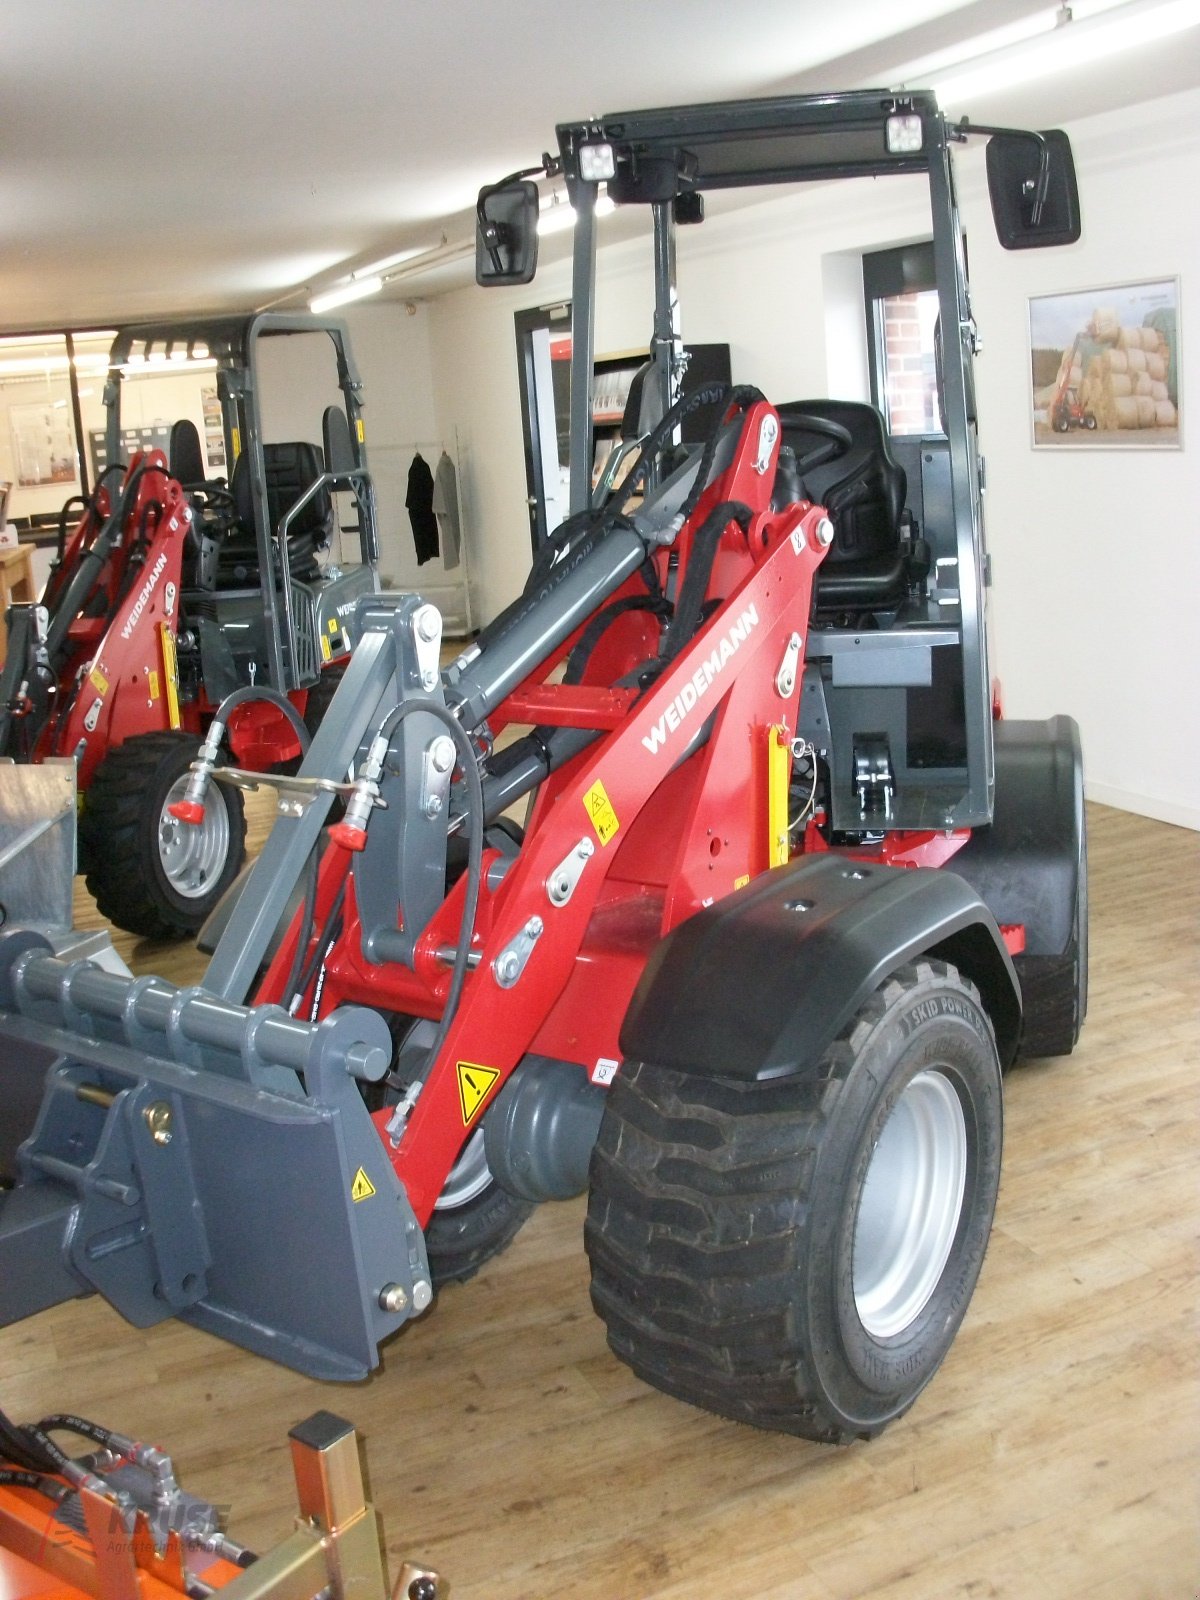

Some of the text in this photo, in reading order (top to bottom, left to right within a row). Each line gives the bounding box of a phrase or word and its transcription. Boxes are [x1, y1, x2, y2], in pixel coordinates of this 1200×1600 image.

[121, 552, 168, 640] WEIDEMANN
[642, 601, 760, 755] WEIDEMANN
[911, 996, 973, 1027] SKID POWER
